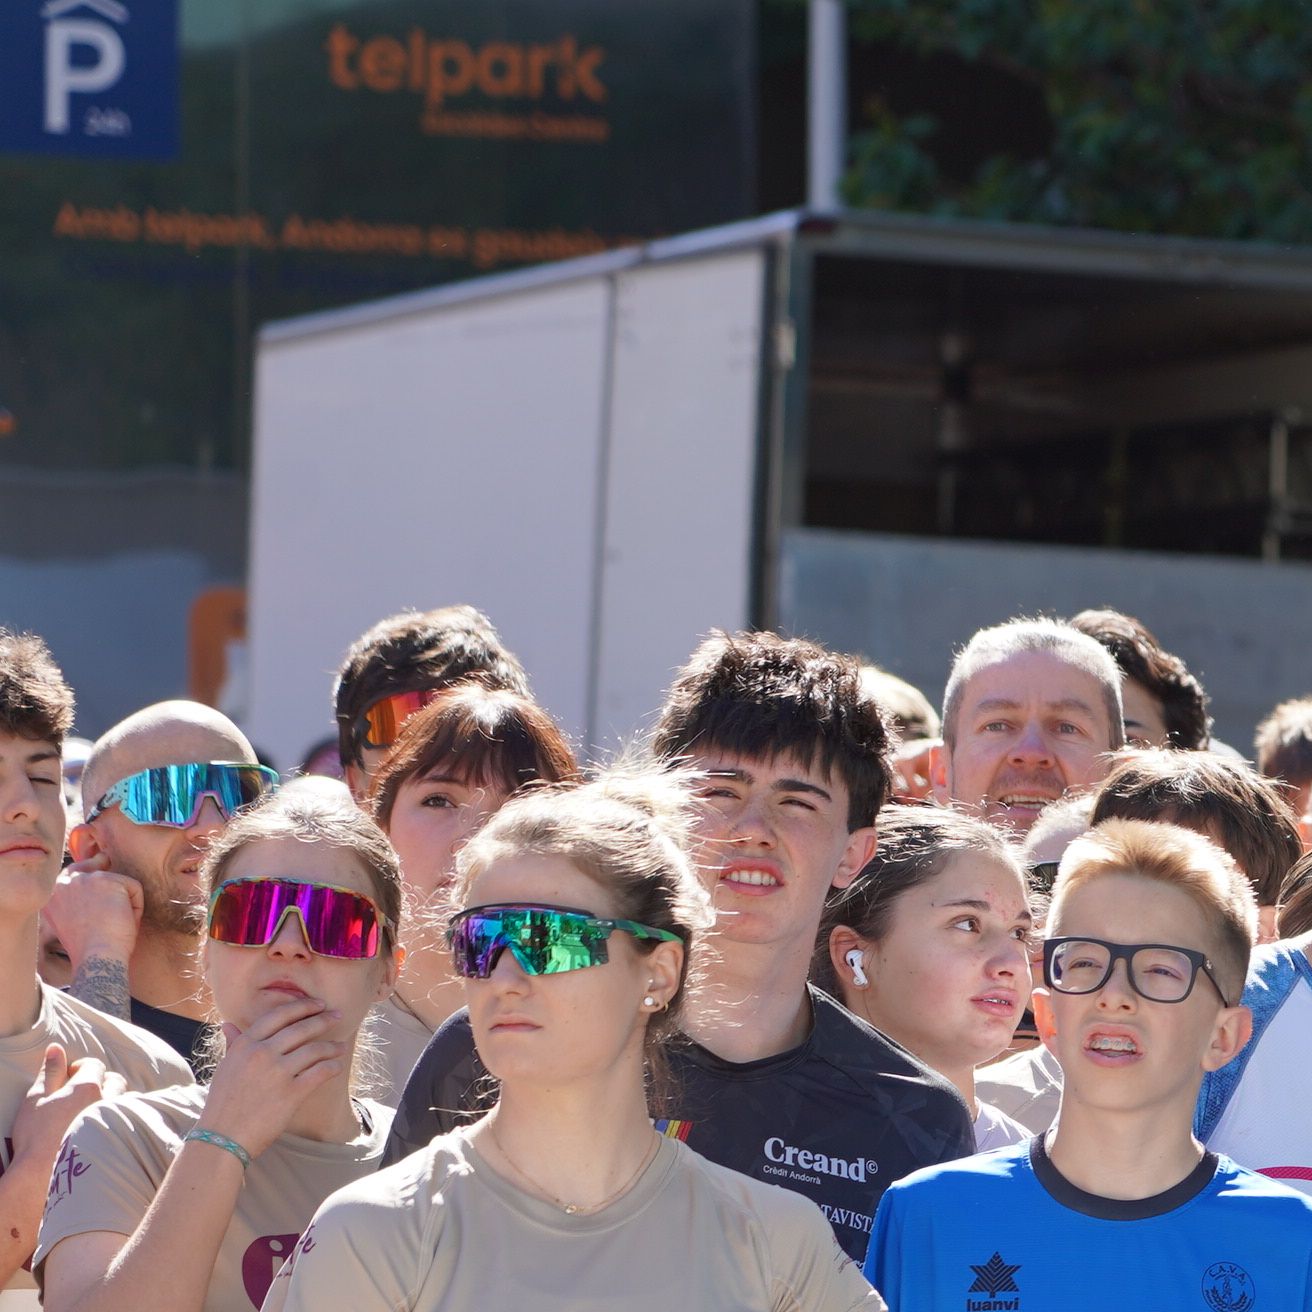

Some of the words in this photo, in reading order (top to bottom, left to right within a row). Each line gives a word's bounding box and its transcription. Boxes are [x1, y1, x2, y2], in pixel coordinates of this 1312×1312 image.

[45, 18, 126, 135] P
[329, 23, 608, 111] telpark
[820, 1204, 876, 1235] TAVIST
[966, 1299, 1020, 1312] luanvi
